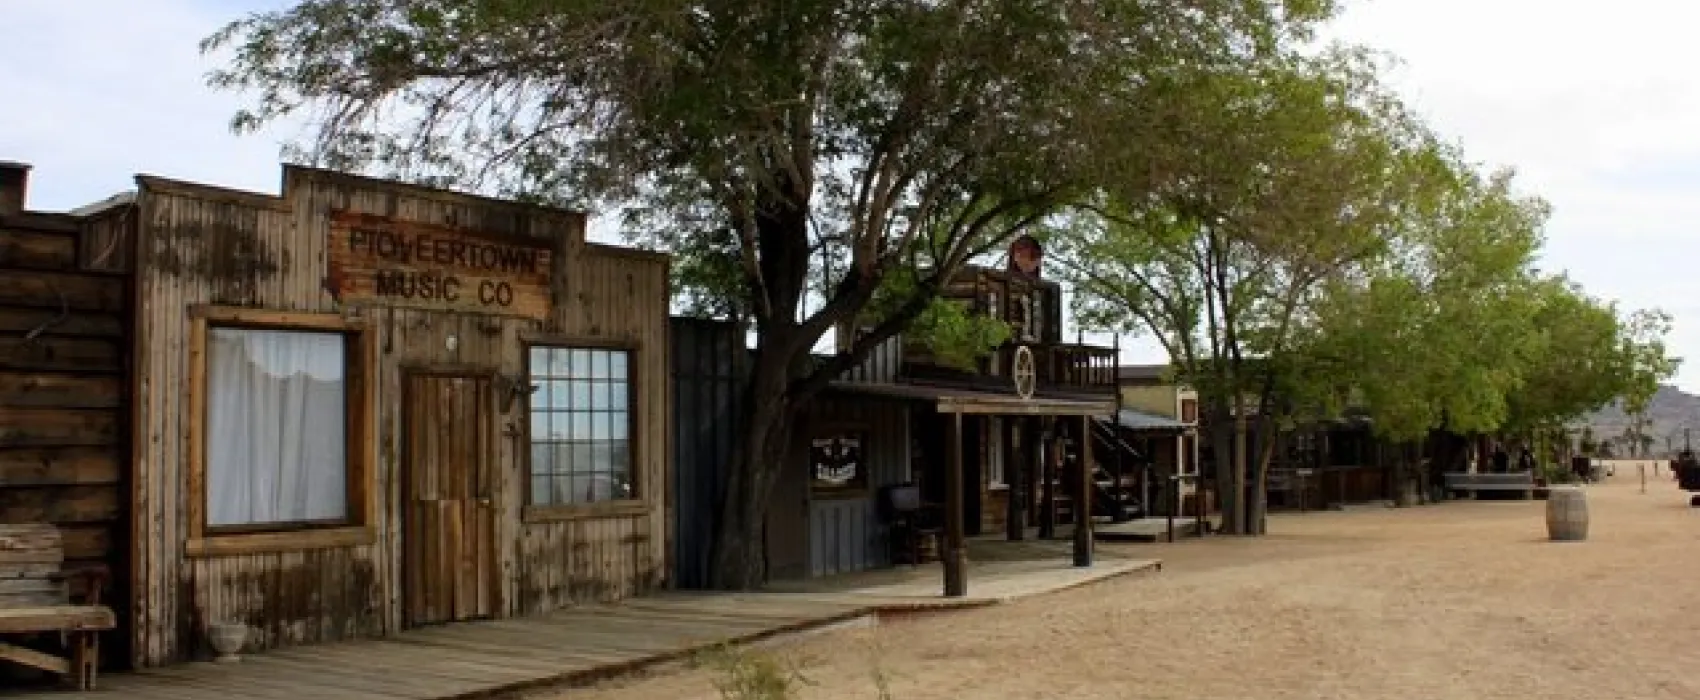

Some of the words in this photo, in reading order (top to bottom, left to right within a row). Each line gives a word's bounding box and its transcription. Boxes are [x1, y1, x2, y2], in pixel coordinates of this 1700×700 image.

[349, 229, 537, 273] PIONEERTOWN
[375, 268, 461, 302] MUSIC
[477, 278, 514, 307] CO
